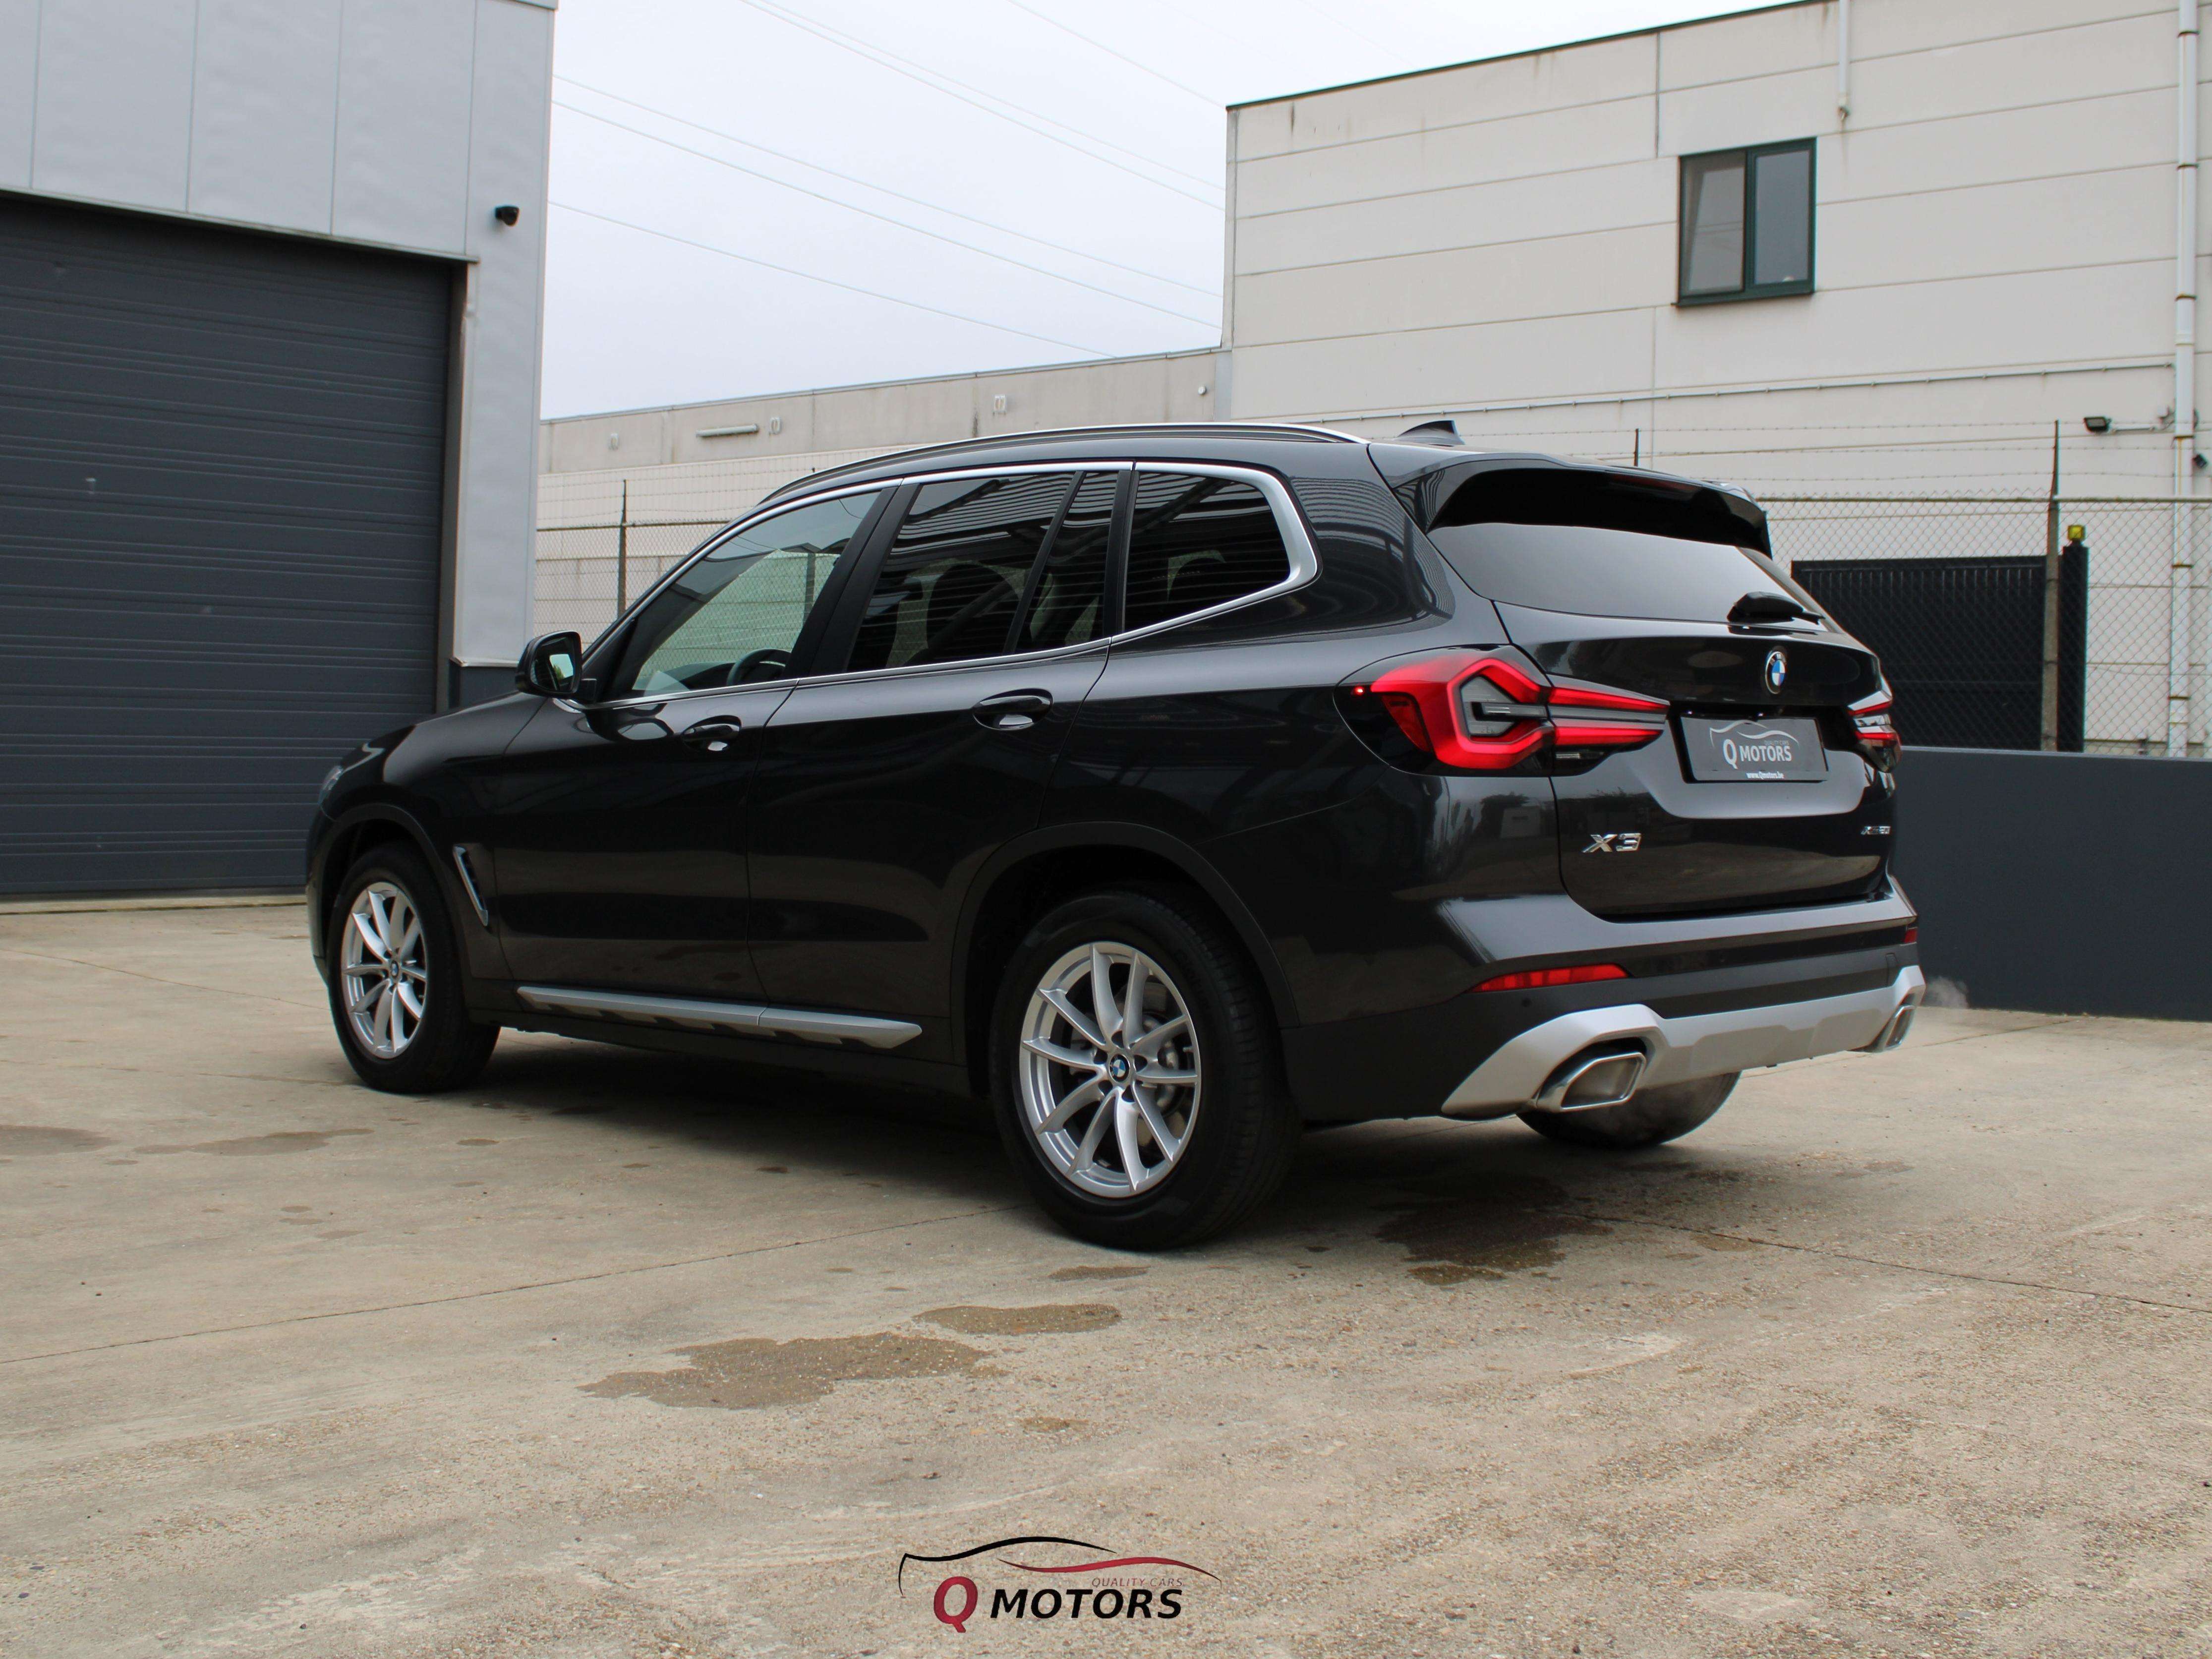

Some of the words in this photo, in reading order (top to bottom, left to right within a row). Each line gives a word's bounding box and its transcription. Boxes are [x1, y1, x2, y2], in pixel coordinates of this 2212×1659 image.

[1723, 739, 1738, 769] Q
[1740, 745, 1792, 761] MOTORS
[1581, 832, 1641, 853] X3
